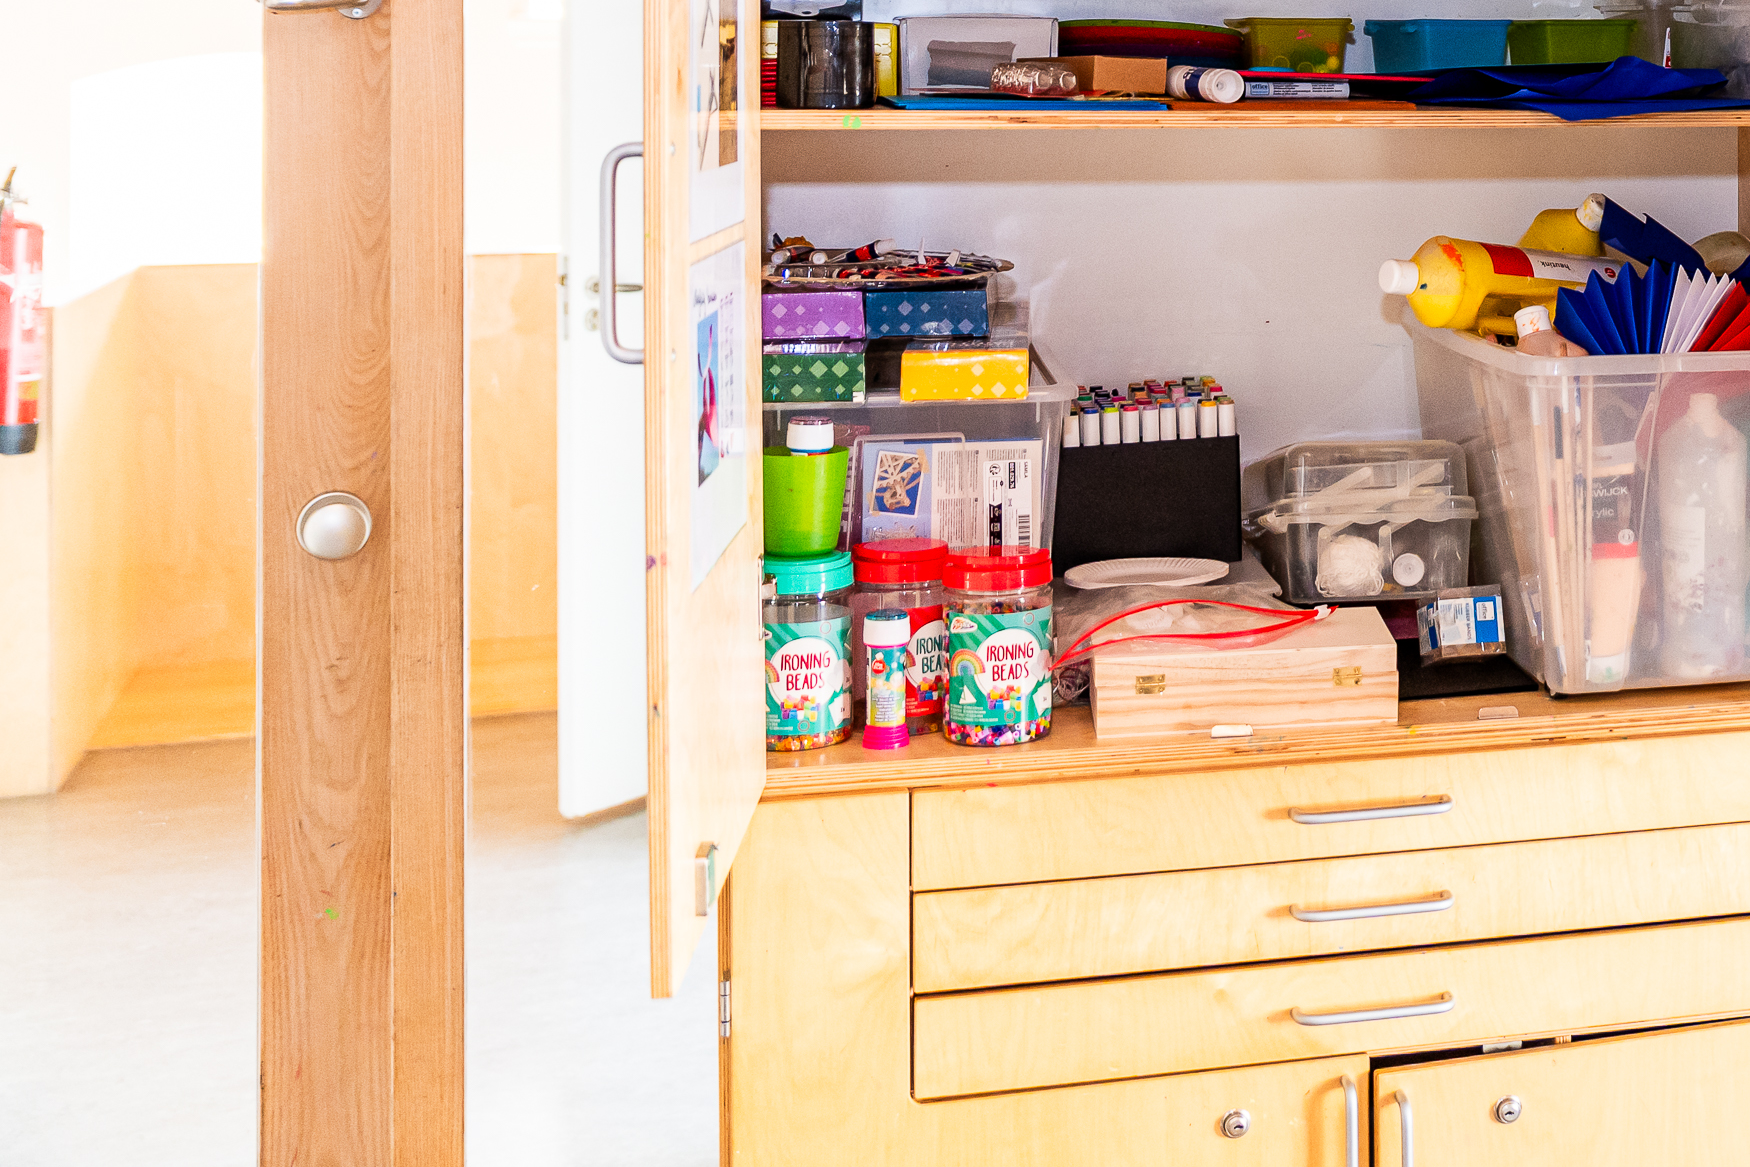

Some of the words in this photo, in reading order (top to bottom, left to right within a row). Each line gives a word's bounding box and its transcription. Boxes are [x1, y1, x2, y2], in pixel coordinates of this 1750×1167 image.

[1592, 486, 1628, 497] WIJCK
[916, 635, 944, 655] IRON
[986, 641, 1034, 662] IRONING
[781, 650, 831, 671] IRONING
[922, 654, 943, 674] BEA
[786, 672, 825, 691] BEADS
[992, 661, 1029, 682] BEADS
